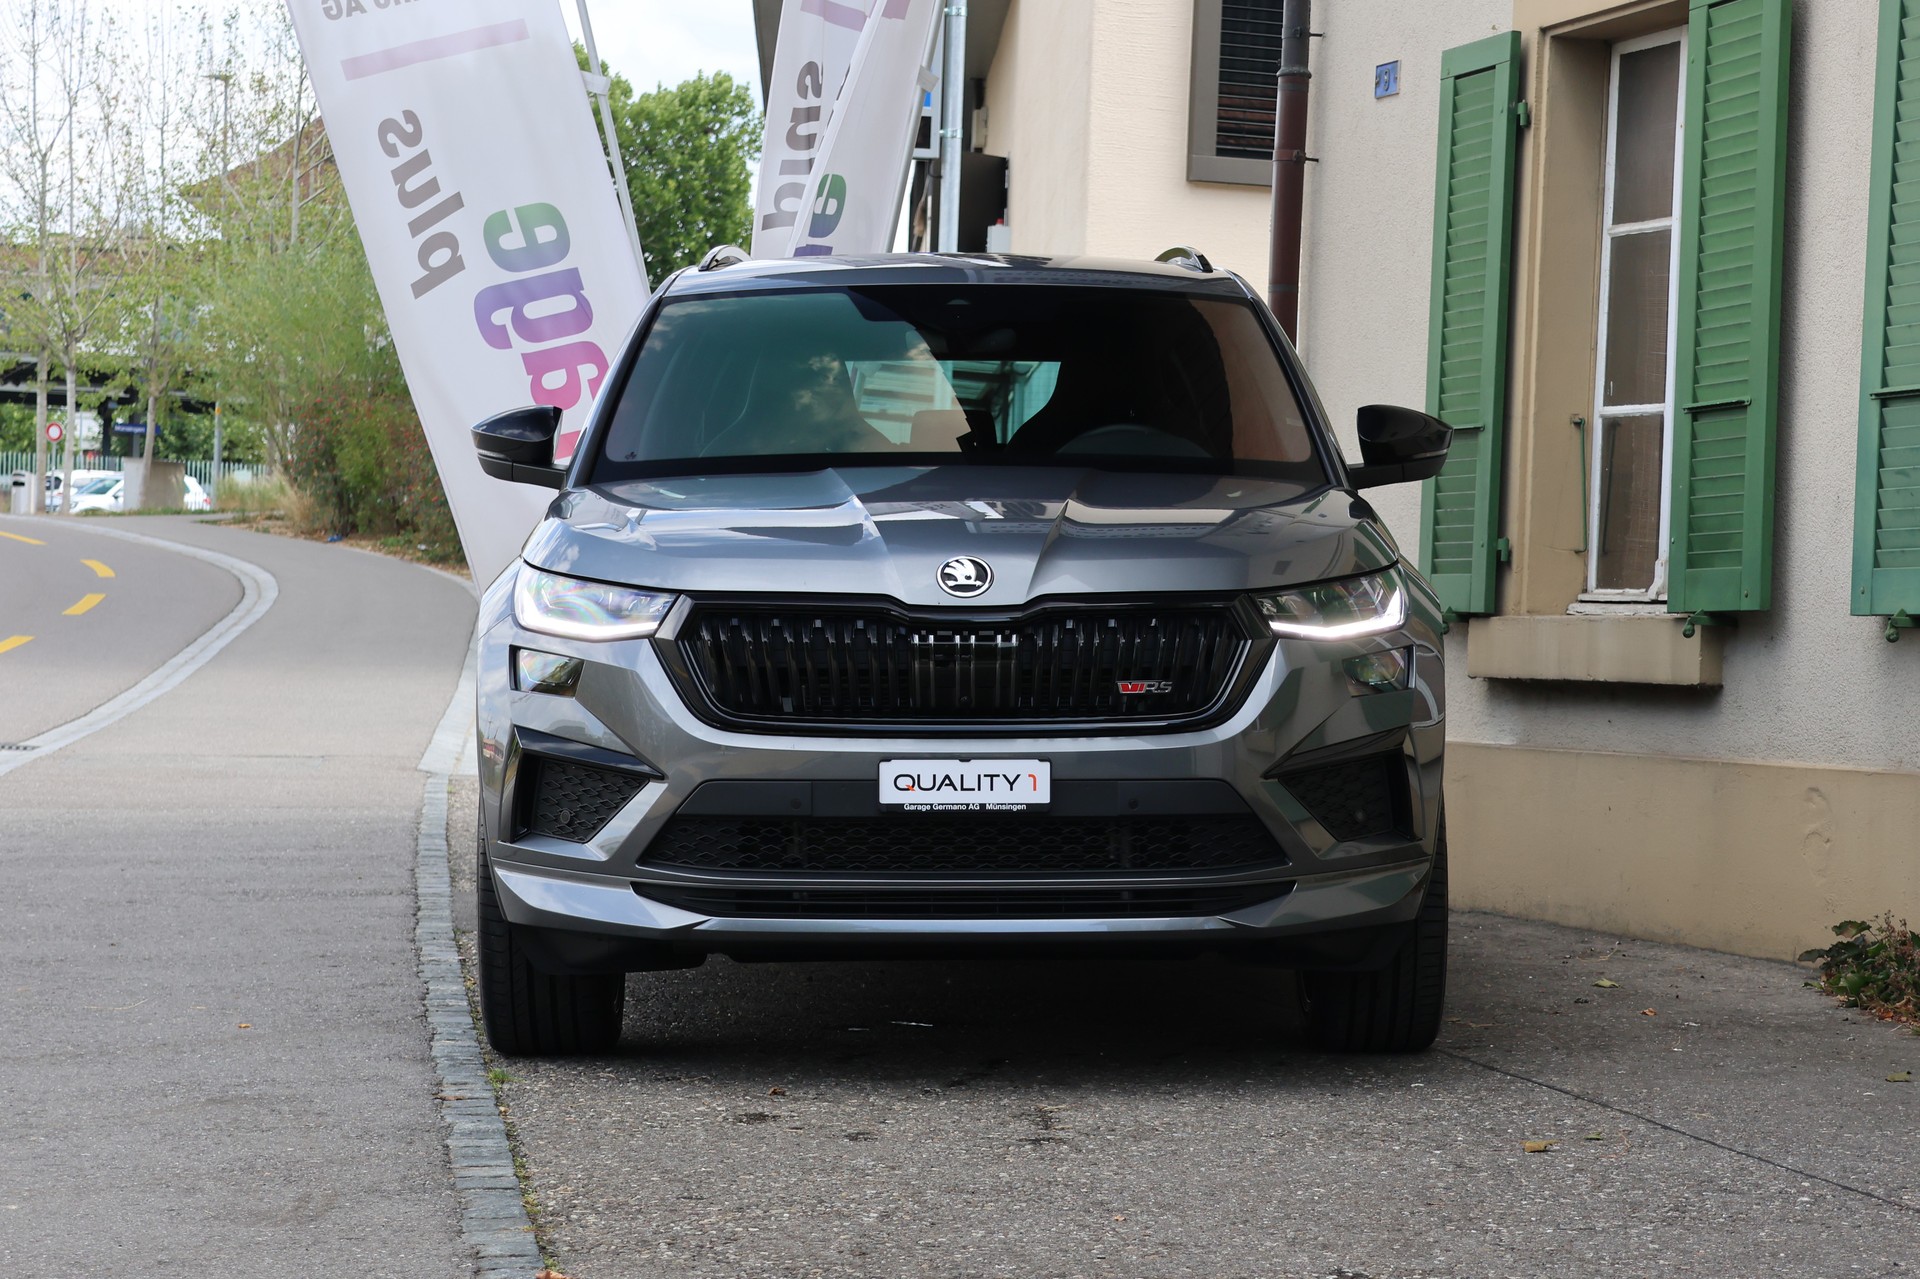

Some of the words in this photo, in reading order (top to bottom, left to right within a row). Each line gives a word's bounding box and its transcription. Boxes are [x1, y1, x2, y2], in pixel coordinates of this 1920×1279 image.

[893, 774, 1021, 792] QUALITY
[1027, 774, 1037, 791] 1
[904, 803, 931, 811] Garage
[985, 803, 1027, 811] Münsingen
